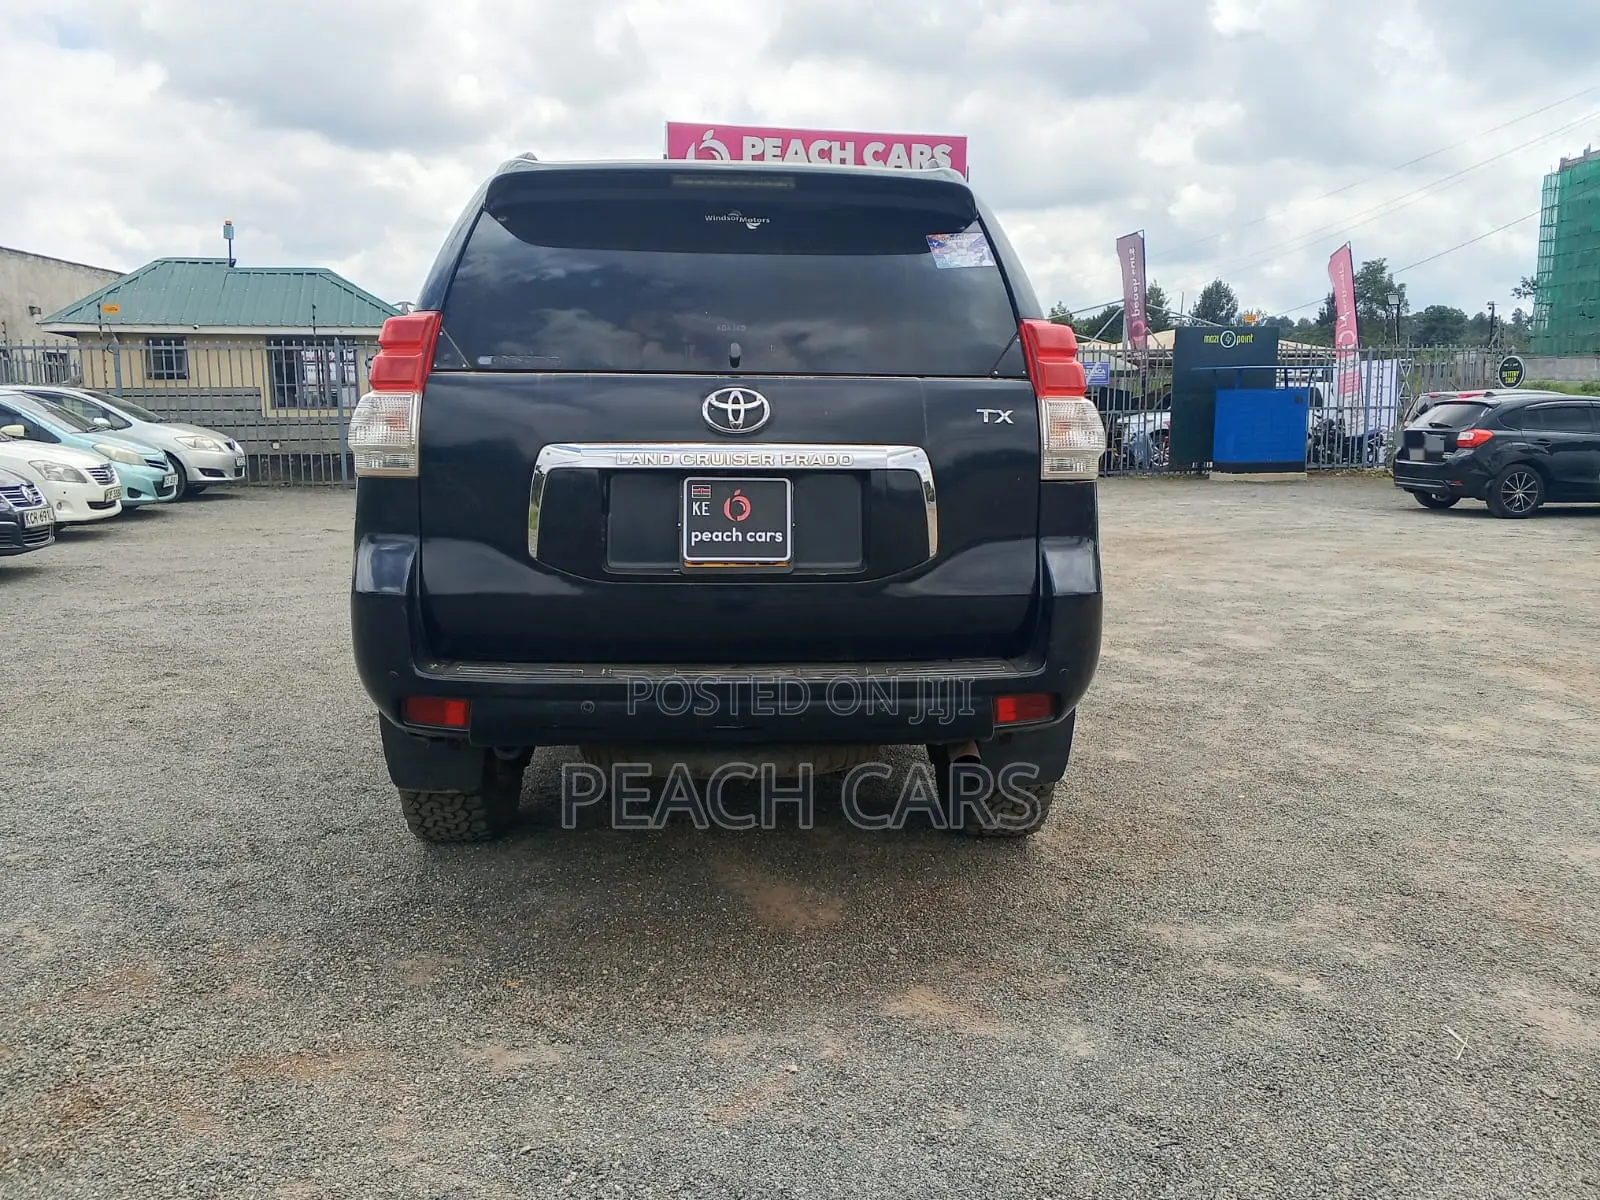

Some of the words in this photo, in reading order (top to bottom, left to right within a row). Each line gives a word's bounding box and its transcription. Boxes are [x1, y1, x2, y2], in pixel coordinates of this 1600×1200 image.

[742, 136, 855, 165] PEACH
[863, 141, 953, 168] CARS
[1236, 333, 1254, 346] point
[976, 408, 1014, 425] TX
[615, 452, 674, 466] LAND
[679, 452, 775, 467] CRUISER
[780, 453, 854, 467] PRADO
[692, 501, 711, 516] KE
[691, 527, 743, 547] peach
[746, 531, 783, 542] cars
